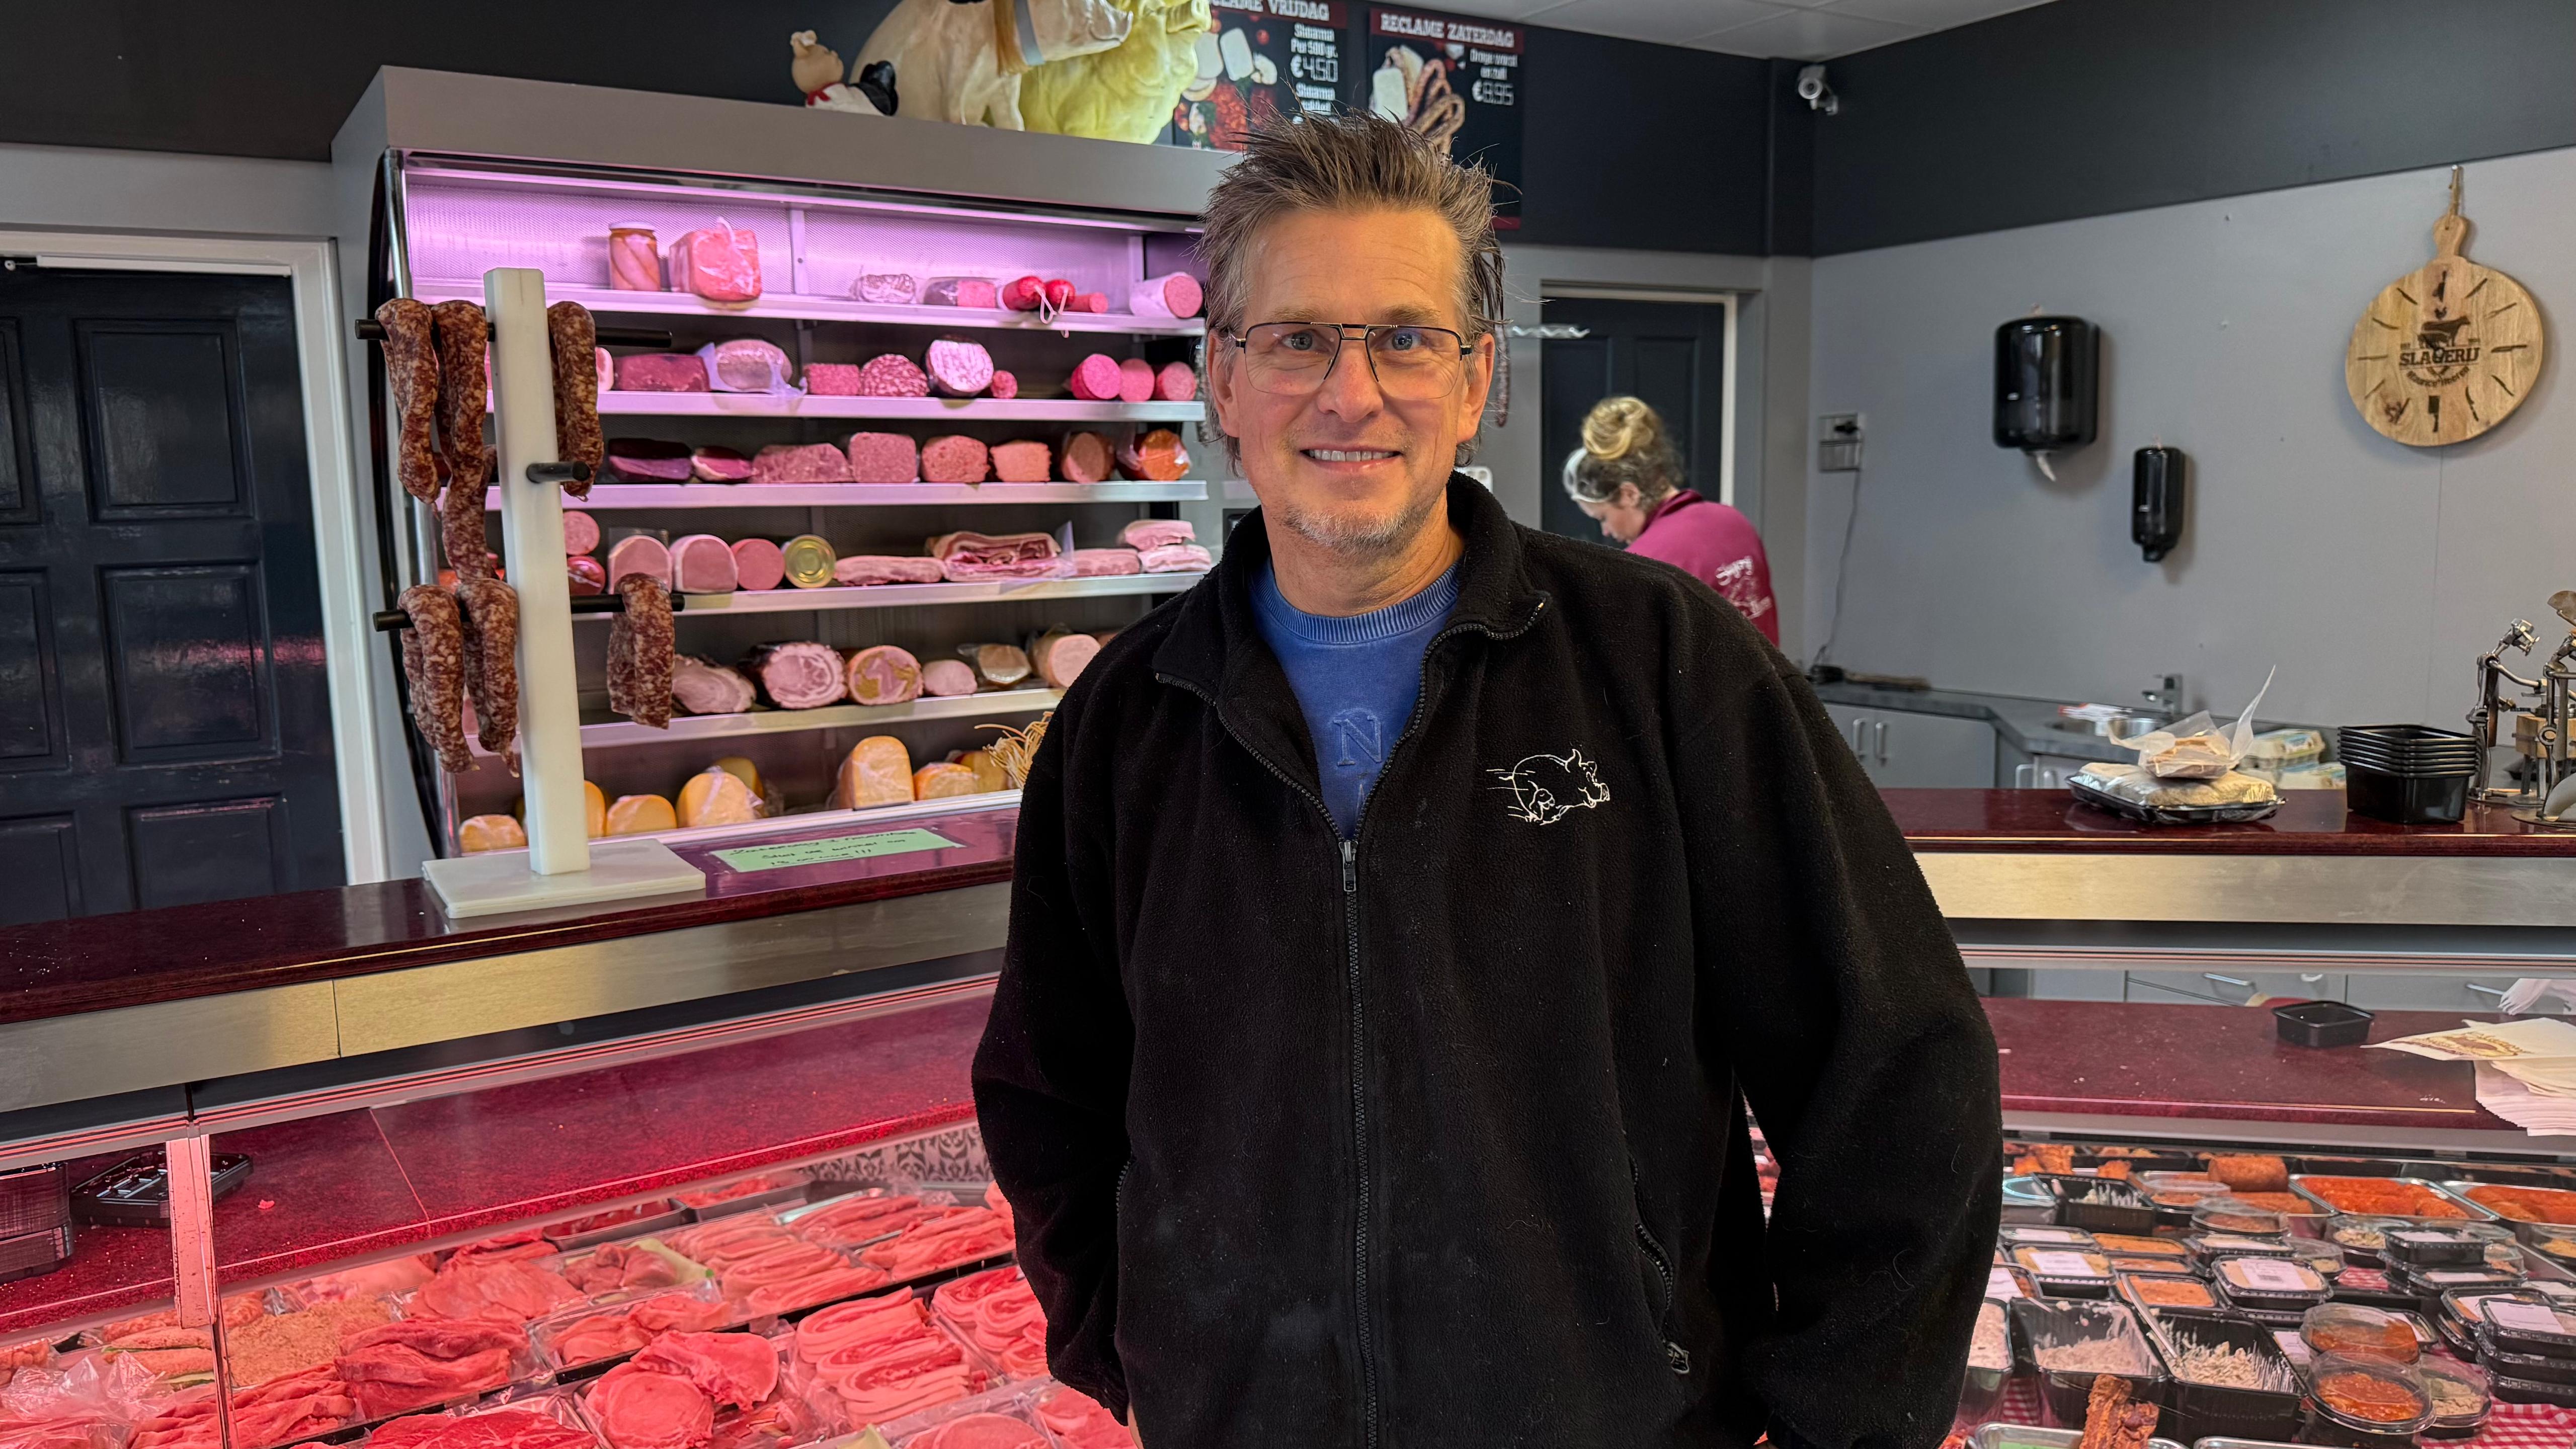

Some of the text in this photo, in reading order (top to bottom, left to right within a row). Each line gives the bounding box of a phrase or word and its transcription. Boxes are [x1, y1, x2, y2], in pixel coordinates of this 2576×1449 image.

[1381, 13, 1514, 48] RECLAME ZATERDAG
[1332, 713, 1382, 766] N
